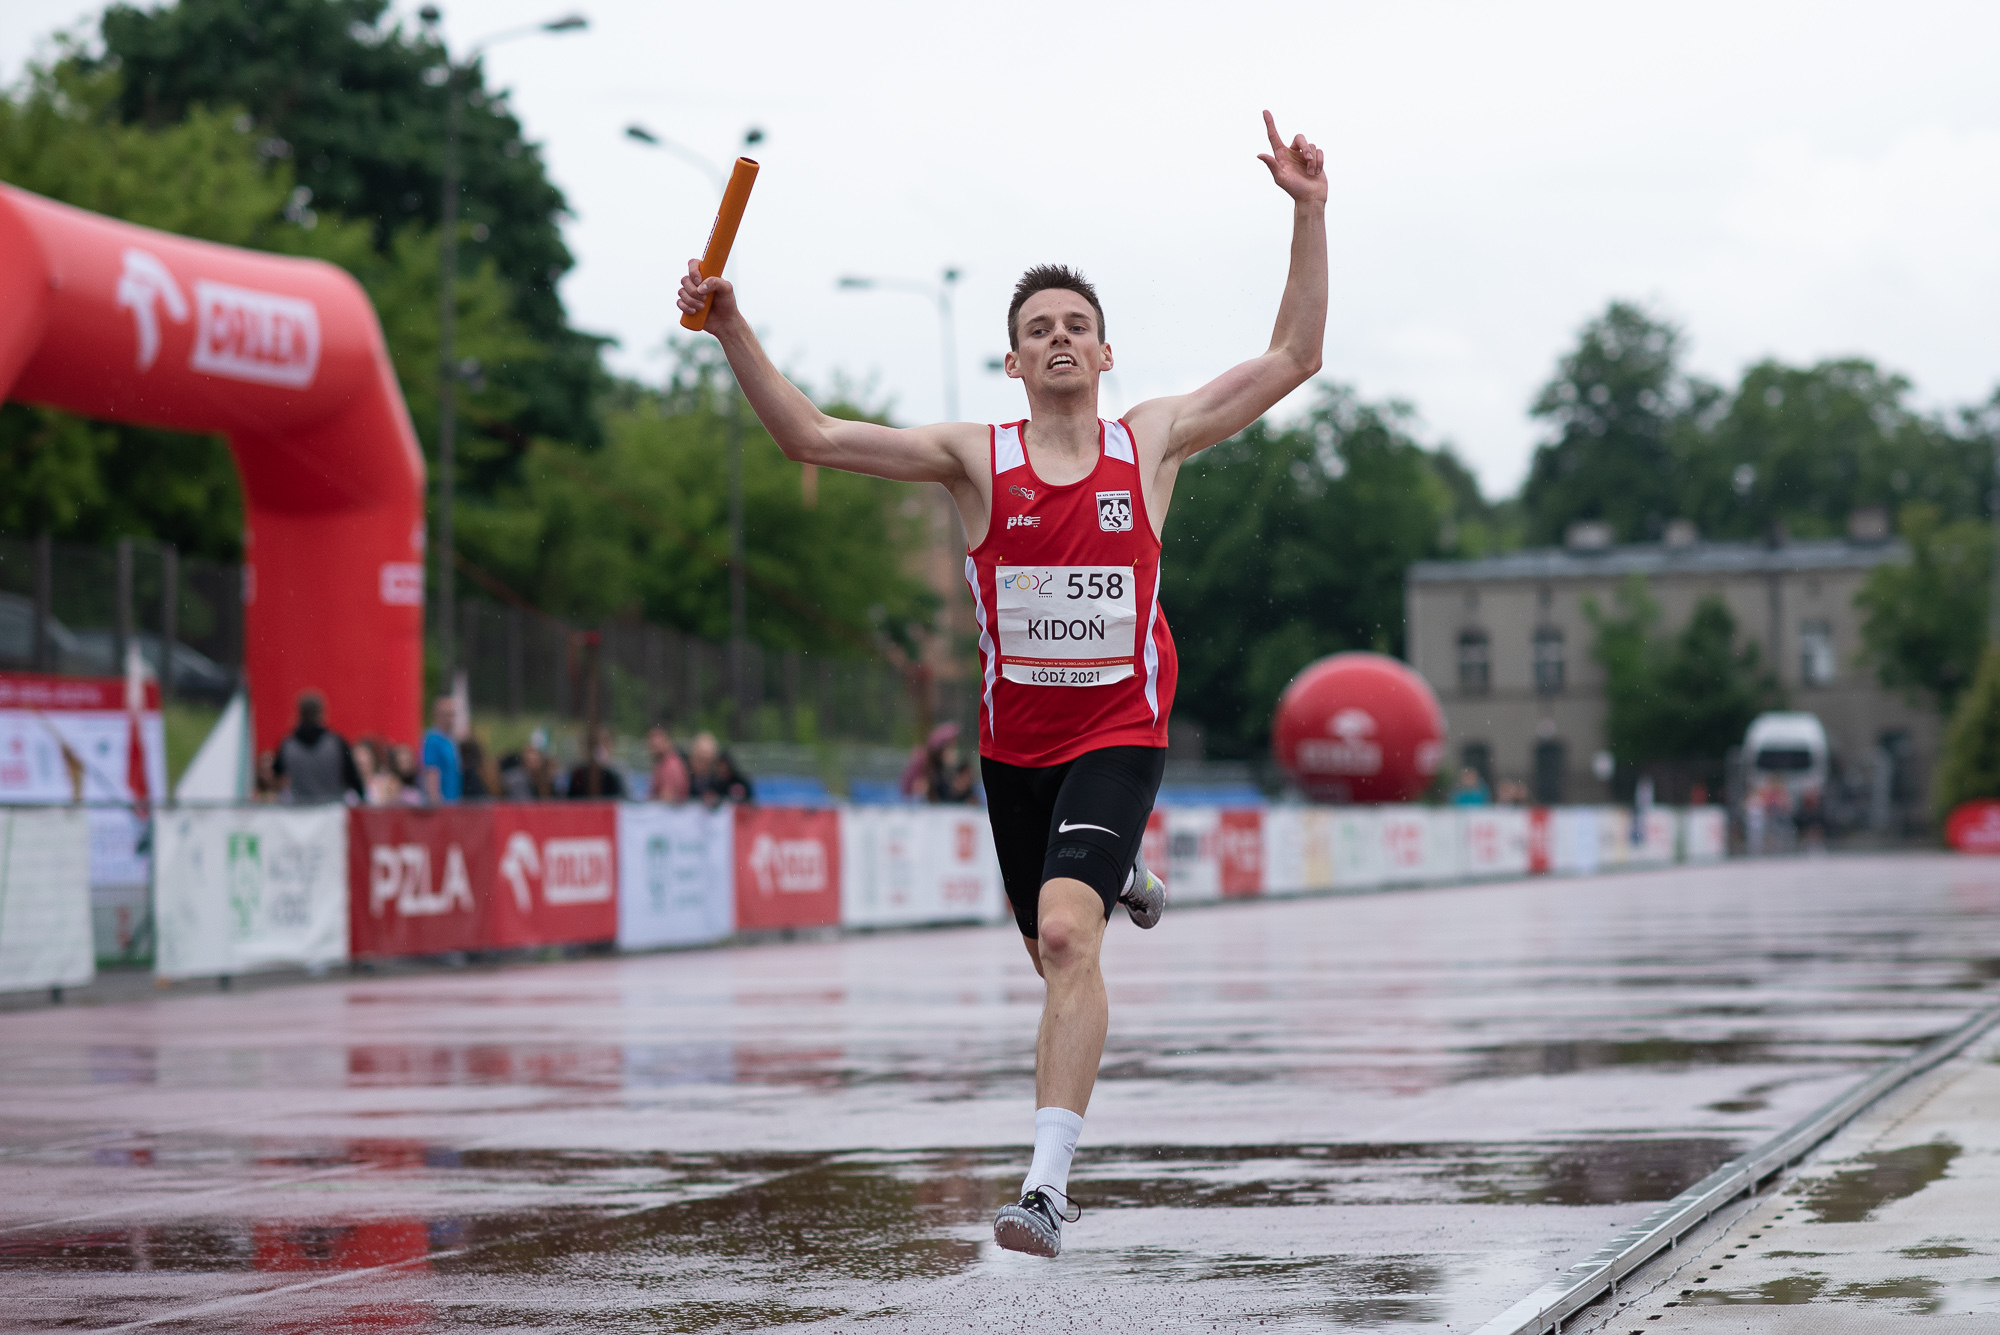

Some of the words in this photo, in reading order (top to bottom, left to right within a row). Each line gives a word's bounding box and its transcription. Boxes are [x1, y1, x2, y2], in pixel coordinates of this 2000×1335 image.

[1066, 573, 1123, 599] 558
[1028, 614, 1105, 640] KIDOŃ
[1032, 668, 1066, 683] ŁÓDŹ
[1070, 671, 1100, 683] 2021
[370, 844, 474, 918] PZLA
